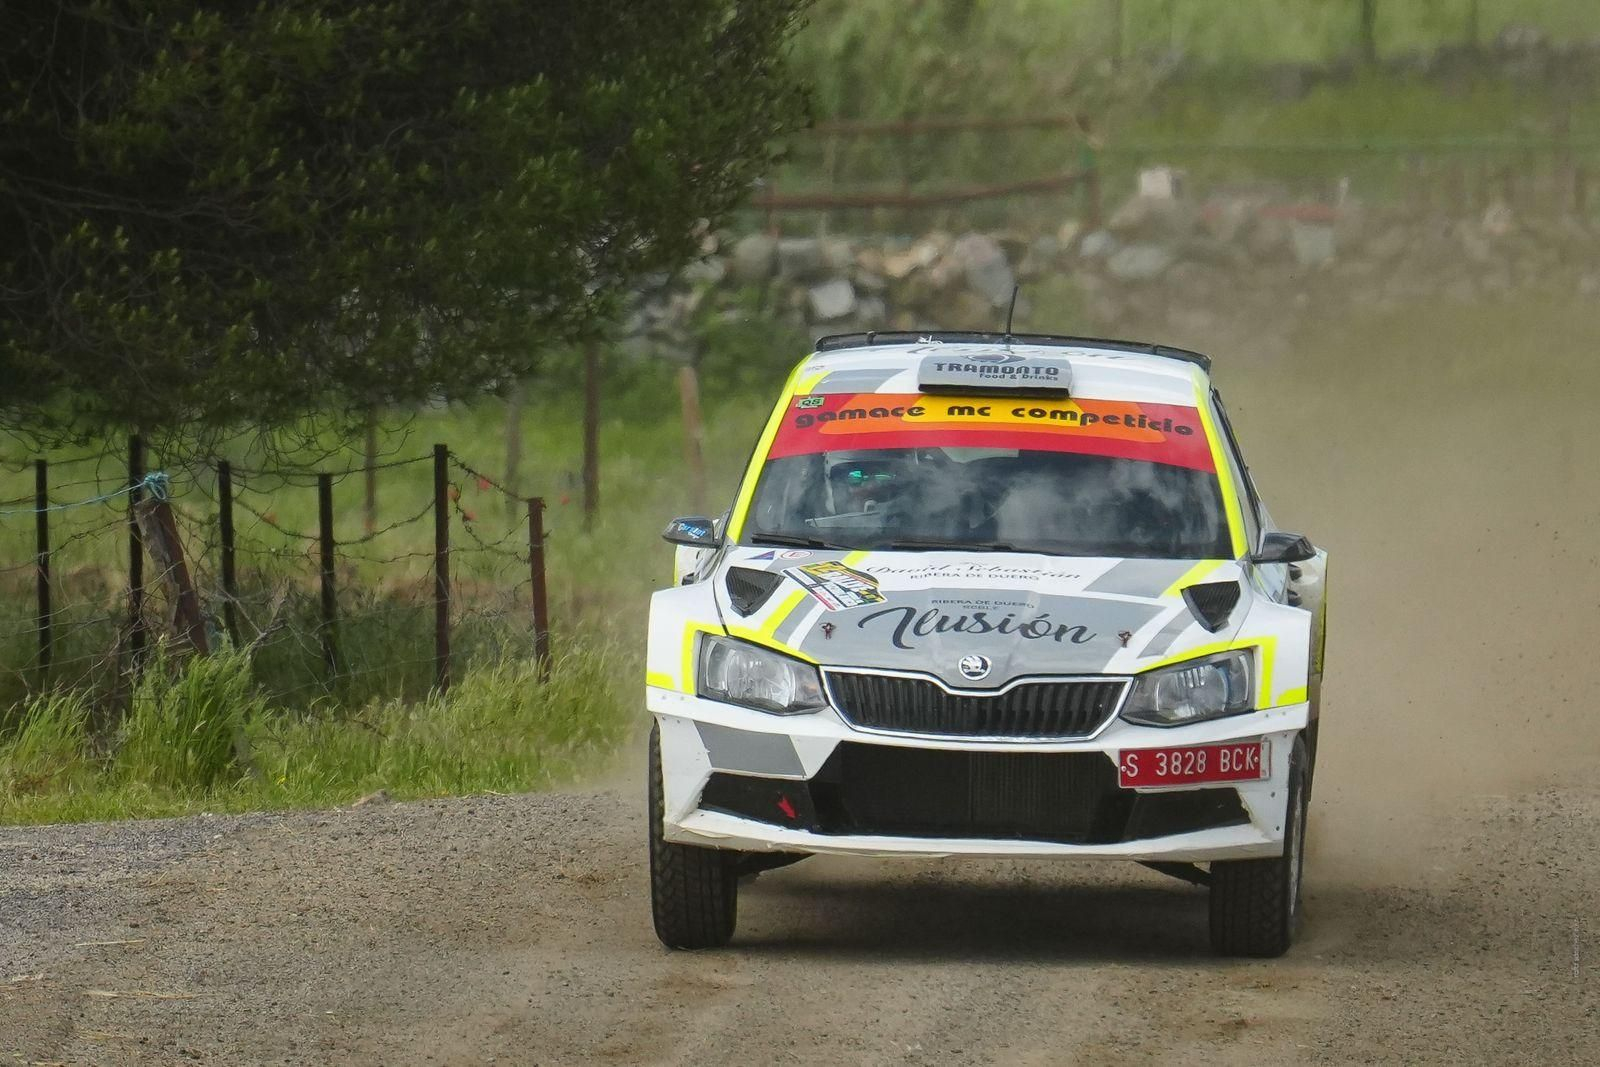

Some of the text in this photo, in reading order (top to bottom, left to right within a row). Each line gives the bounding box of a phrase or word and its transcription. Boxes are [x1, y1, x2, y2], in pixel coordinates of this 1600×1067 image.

[934, 363, 1059, 376] TRAMONTO
[795, 405, 1193, 435] gamace mc competicio
[857, 607, 1098, 649] Ilusión
[1126, 747, 1256, 777] S 3828 BCK
